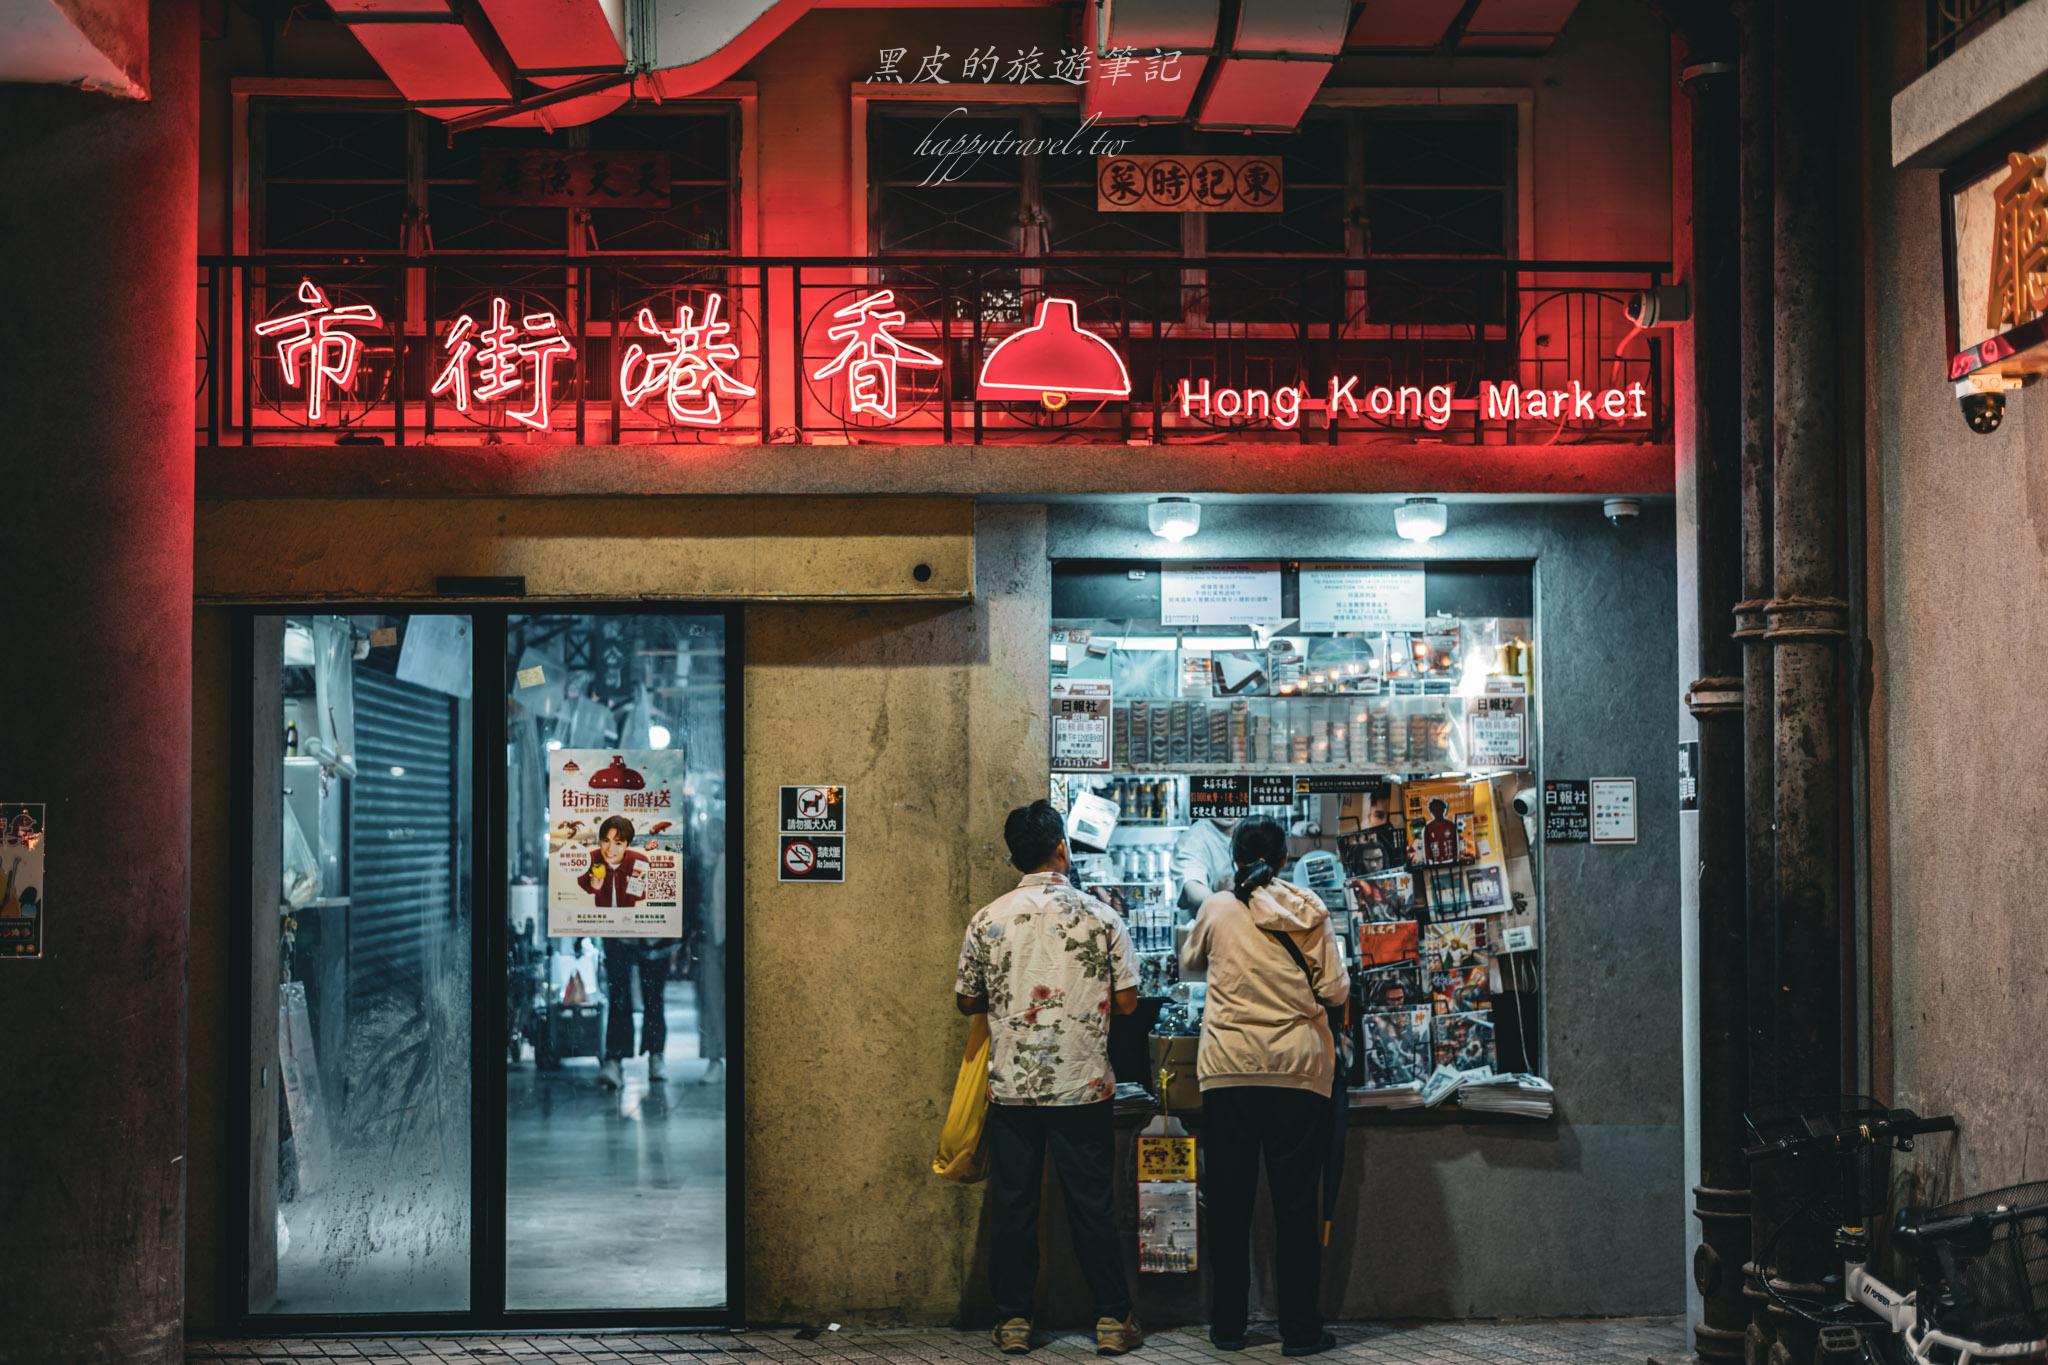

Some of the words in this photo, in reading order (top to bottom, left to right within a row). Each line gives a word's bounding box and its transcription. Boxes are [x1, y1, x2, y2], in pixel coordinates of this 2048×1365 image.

[1181, 378, 1302, 428] Hong
[1331, 375, 1452, 425] Kong
[1486, 380, 1648, 419] Market
[1062, 700, 1097, 713] 日報社
[1477, 698, 1513, 710] 日報社
[624, 789, 672, 807] 新鮮送
[1546, 790, 1588, 805] 日報社
[817, 846, 841, 858] 禁煙
[816, 859, 823, 869] No
[823, 859, 841, 872] Smoking
